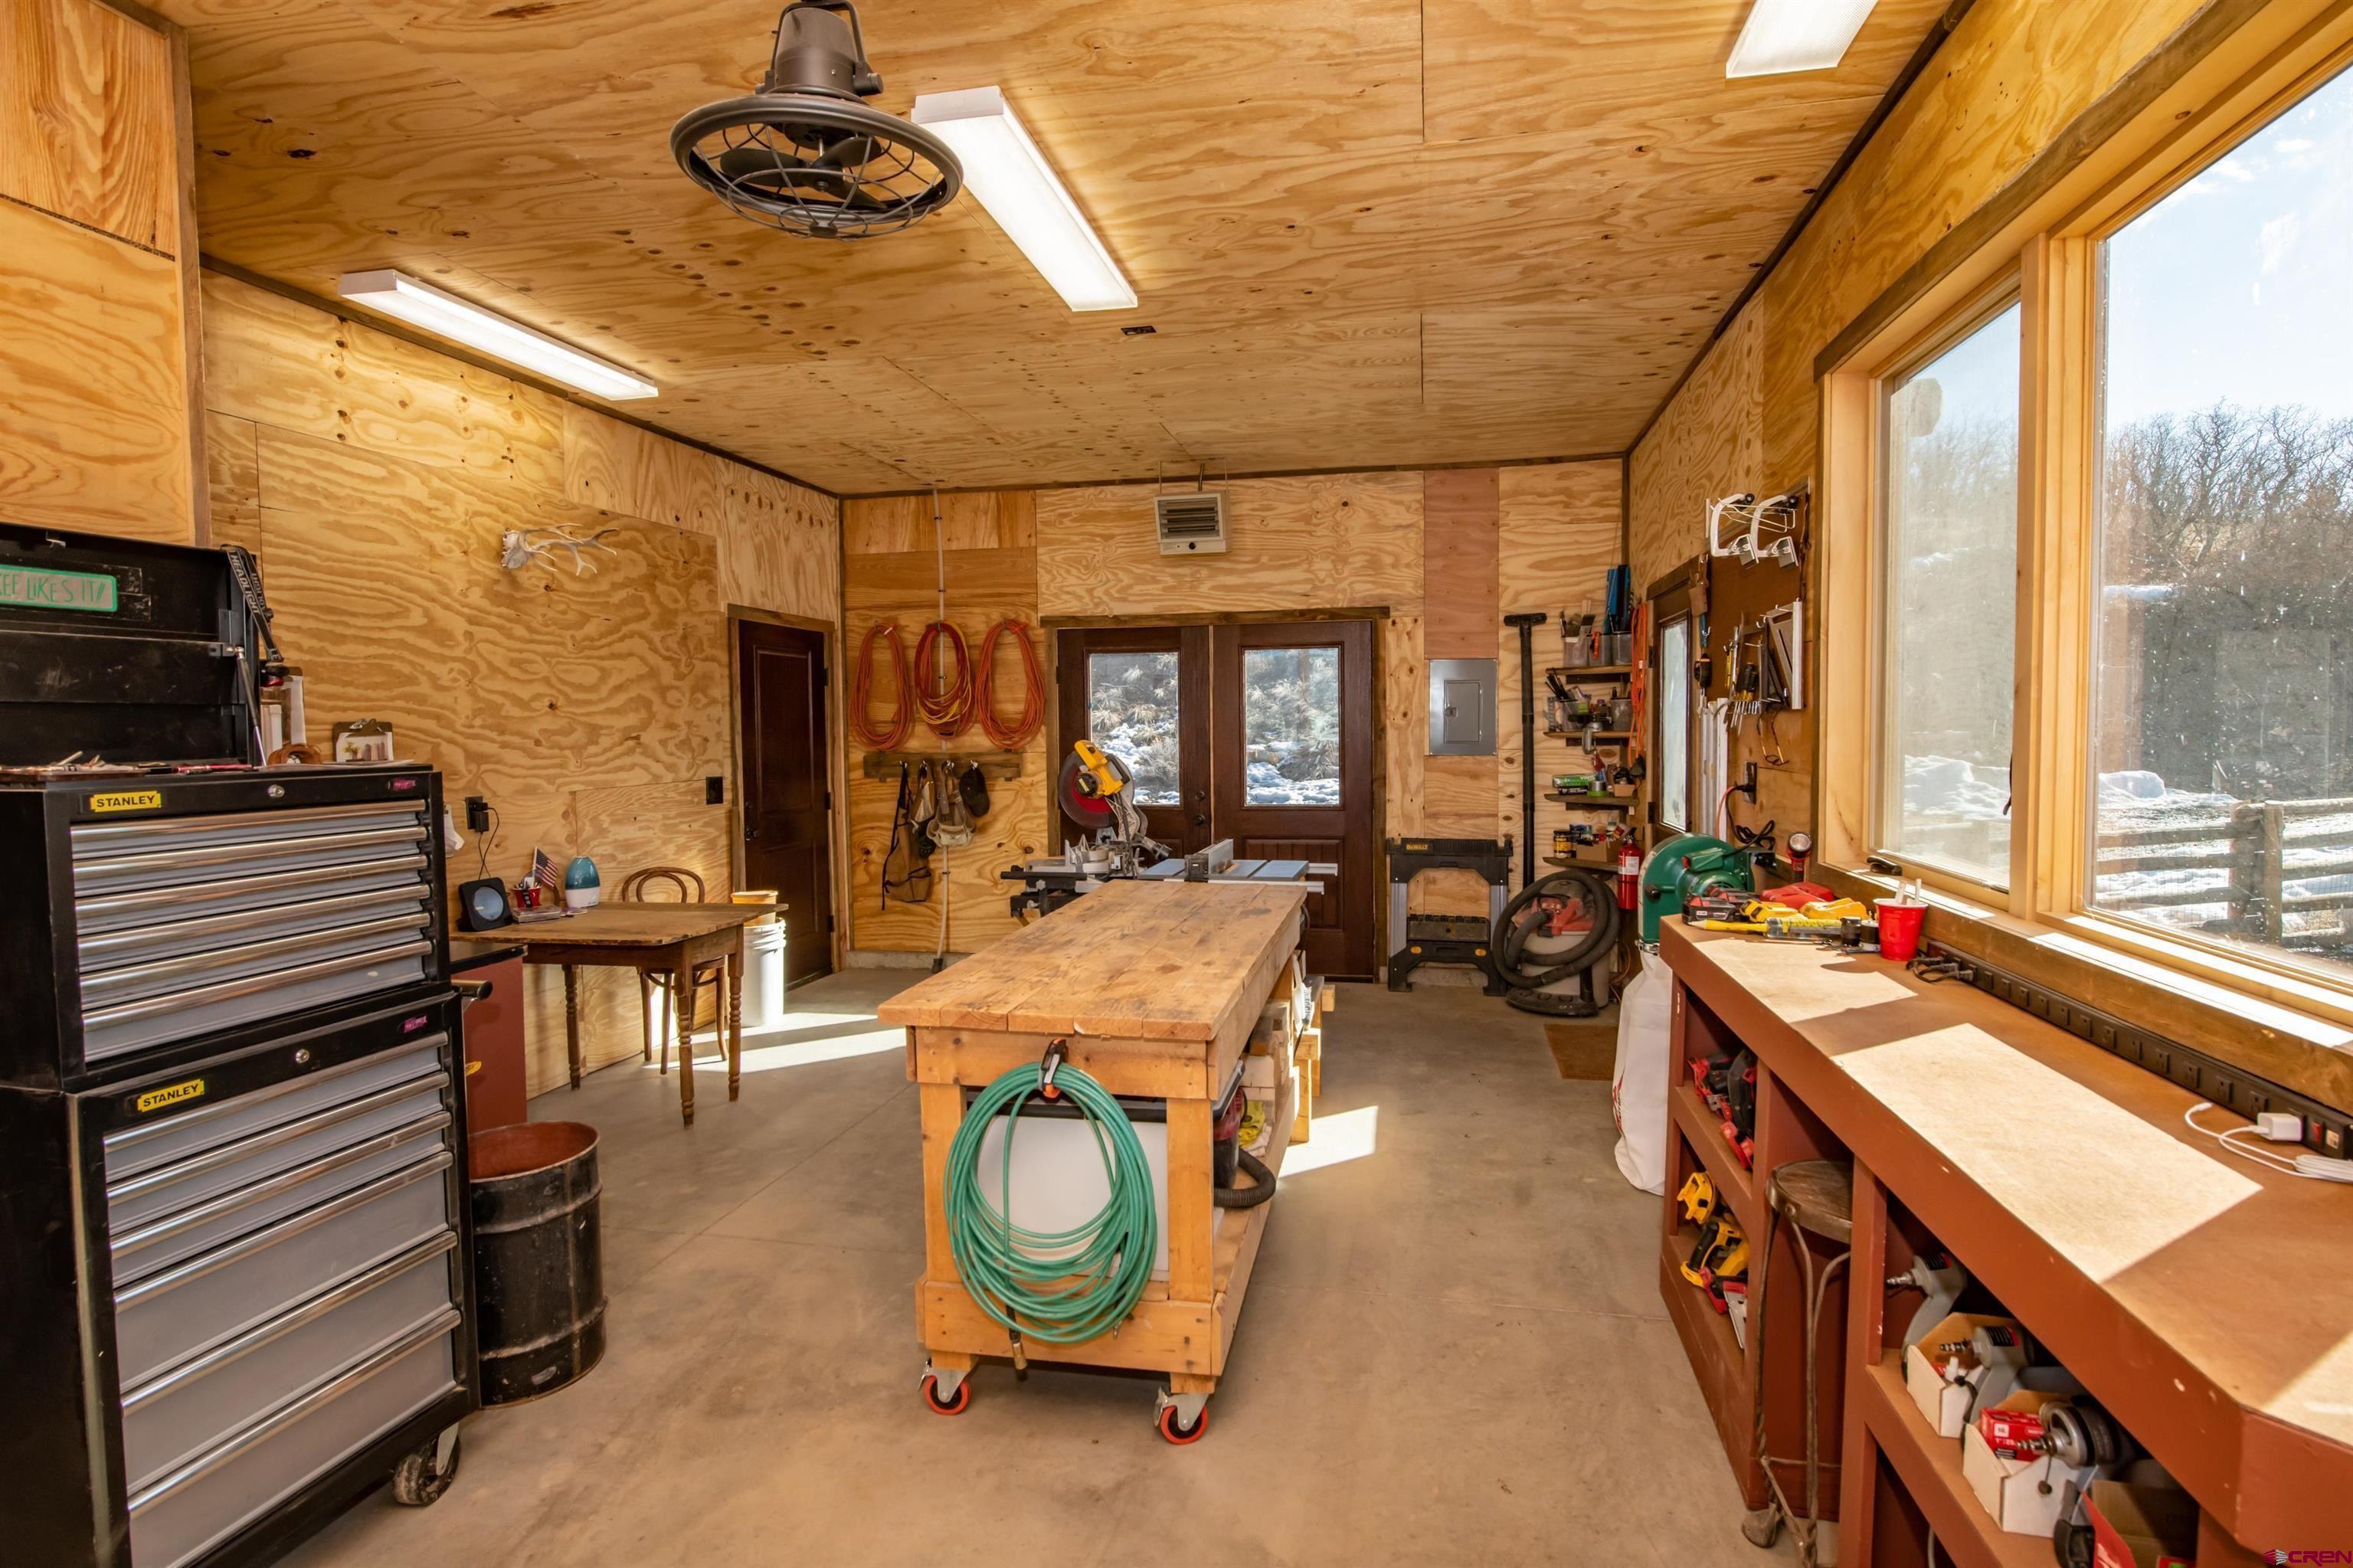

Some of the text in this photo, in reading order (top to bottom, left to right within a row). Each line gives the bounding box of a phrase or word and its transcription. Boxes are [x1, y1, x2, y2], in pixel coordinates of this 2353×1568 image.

[27, 576, 74, 603] LIKES
[231, 554, 261, 614] HEADLIGHT
[97, 794, 155, 808] STANLEY
[143, 1083, 199, 1108] STANLEY
